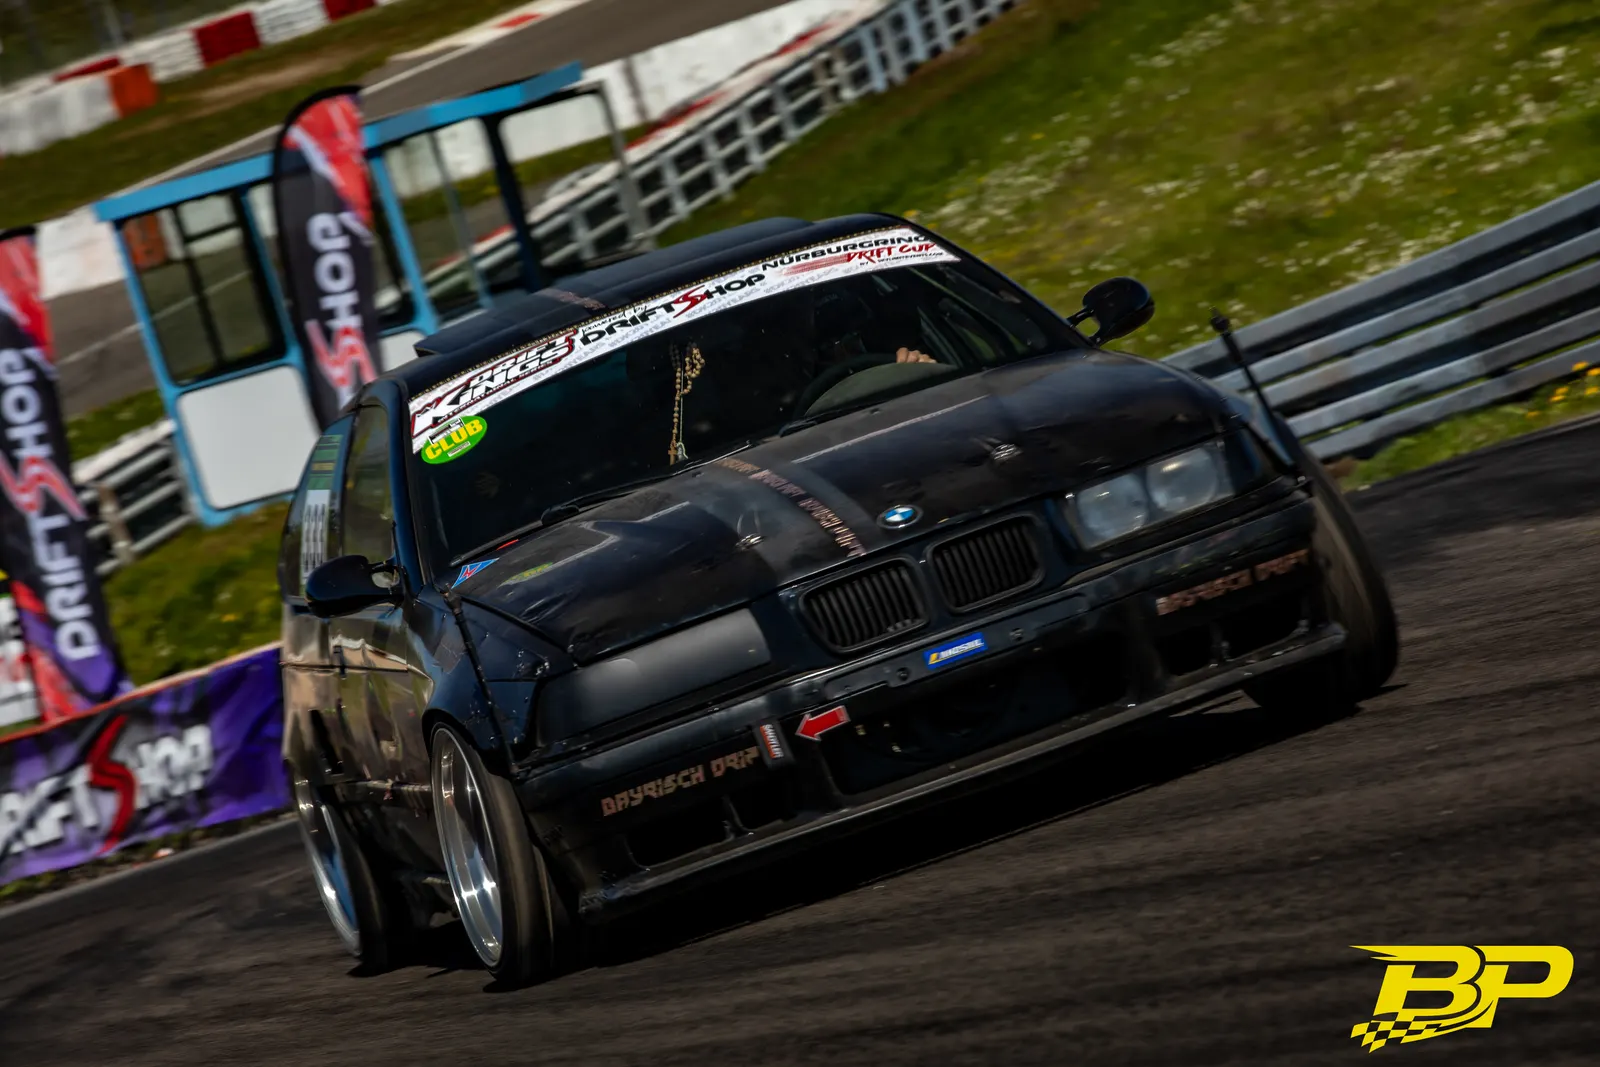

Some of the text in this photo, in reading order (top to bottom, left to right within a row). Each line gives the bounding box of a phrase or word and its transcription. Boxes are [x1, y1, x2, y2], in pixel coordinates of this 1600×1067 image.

[846, 242, 937, 264] DRIFT CUP
[579, 273, 766, 346] DRIFTSHOP
[468, 330, 577, 387] DRIFT
[412, 344, 573, 438] KINGS
[424, 418, 484, 460] CLUB
